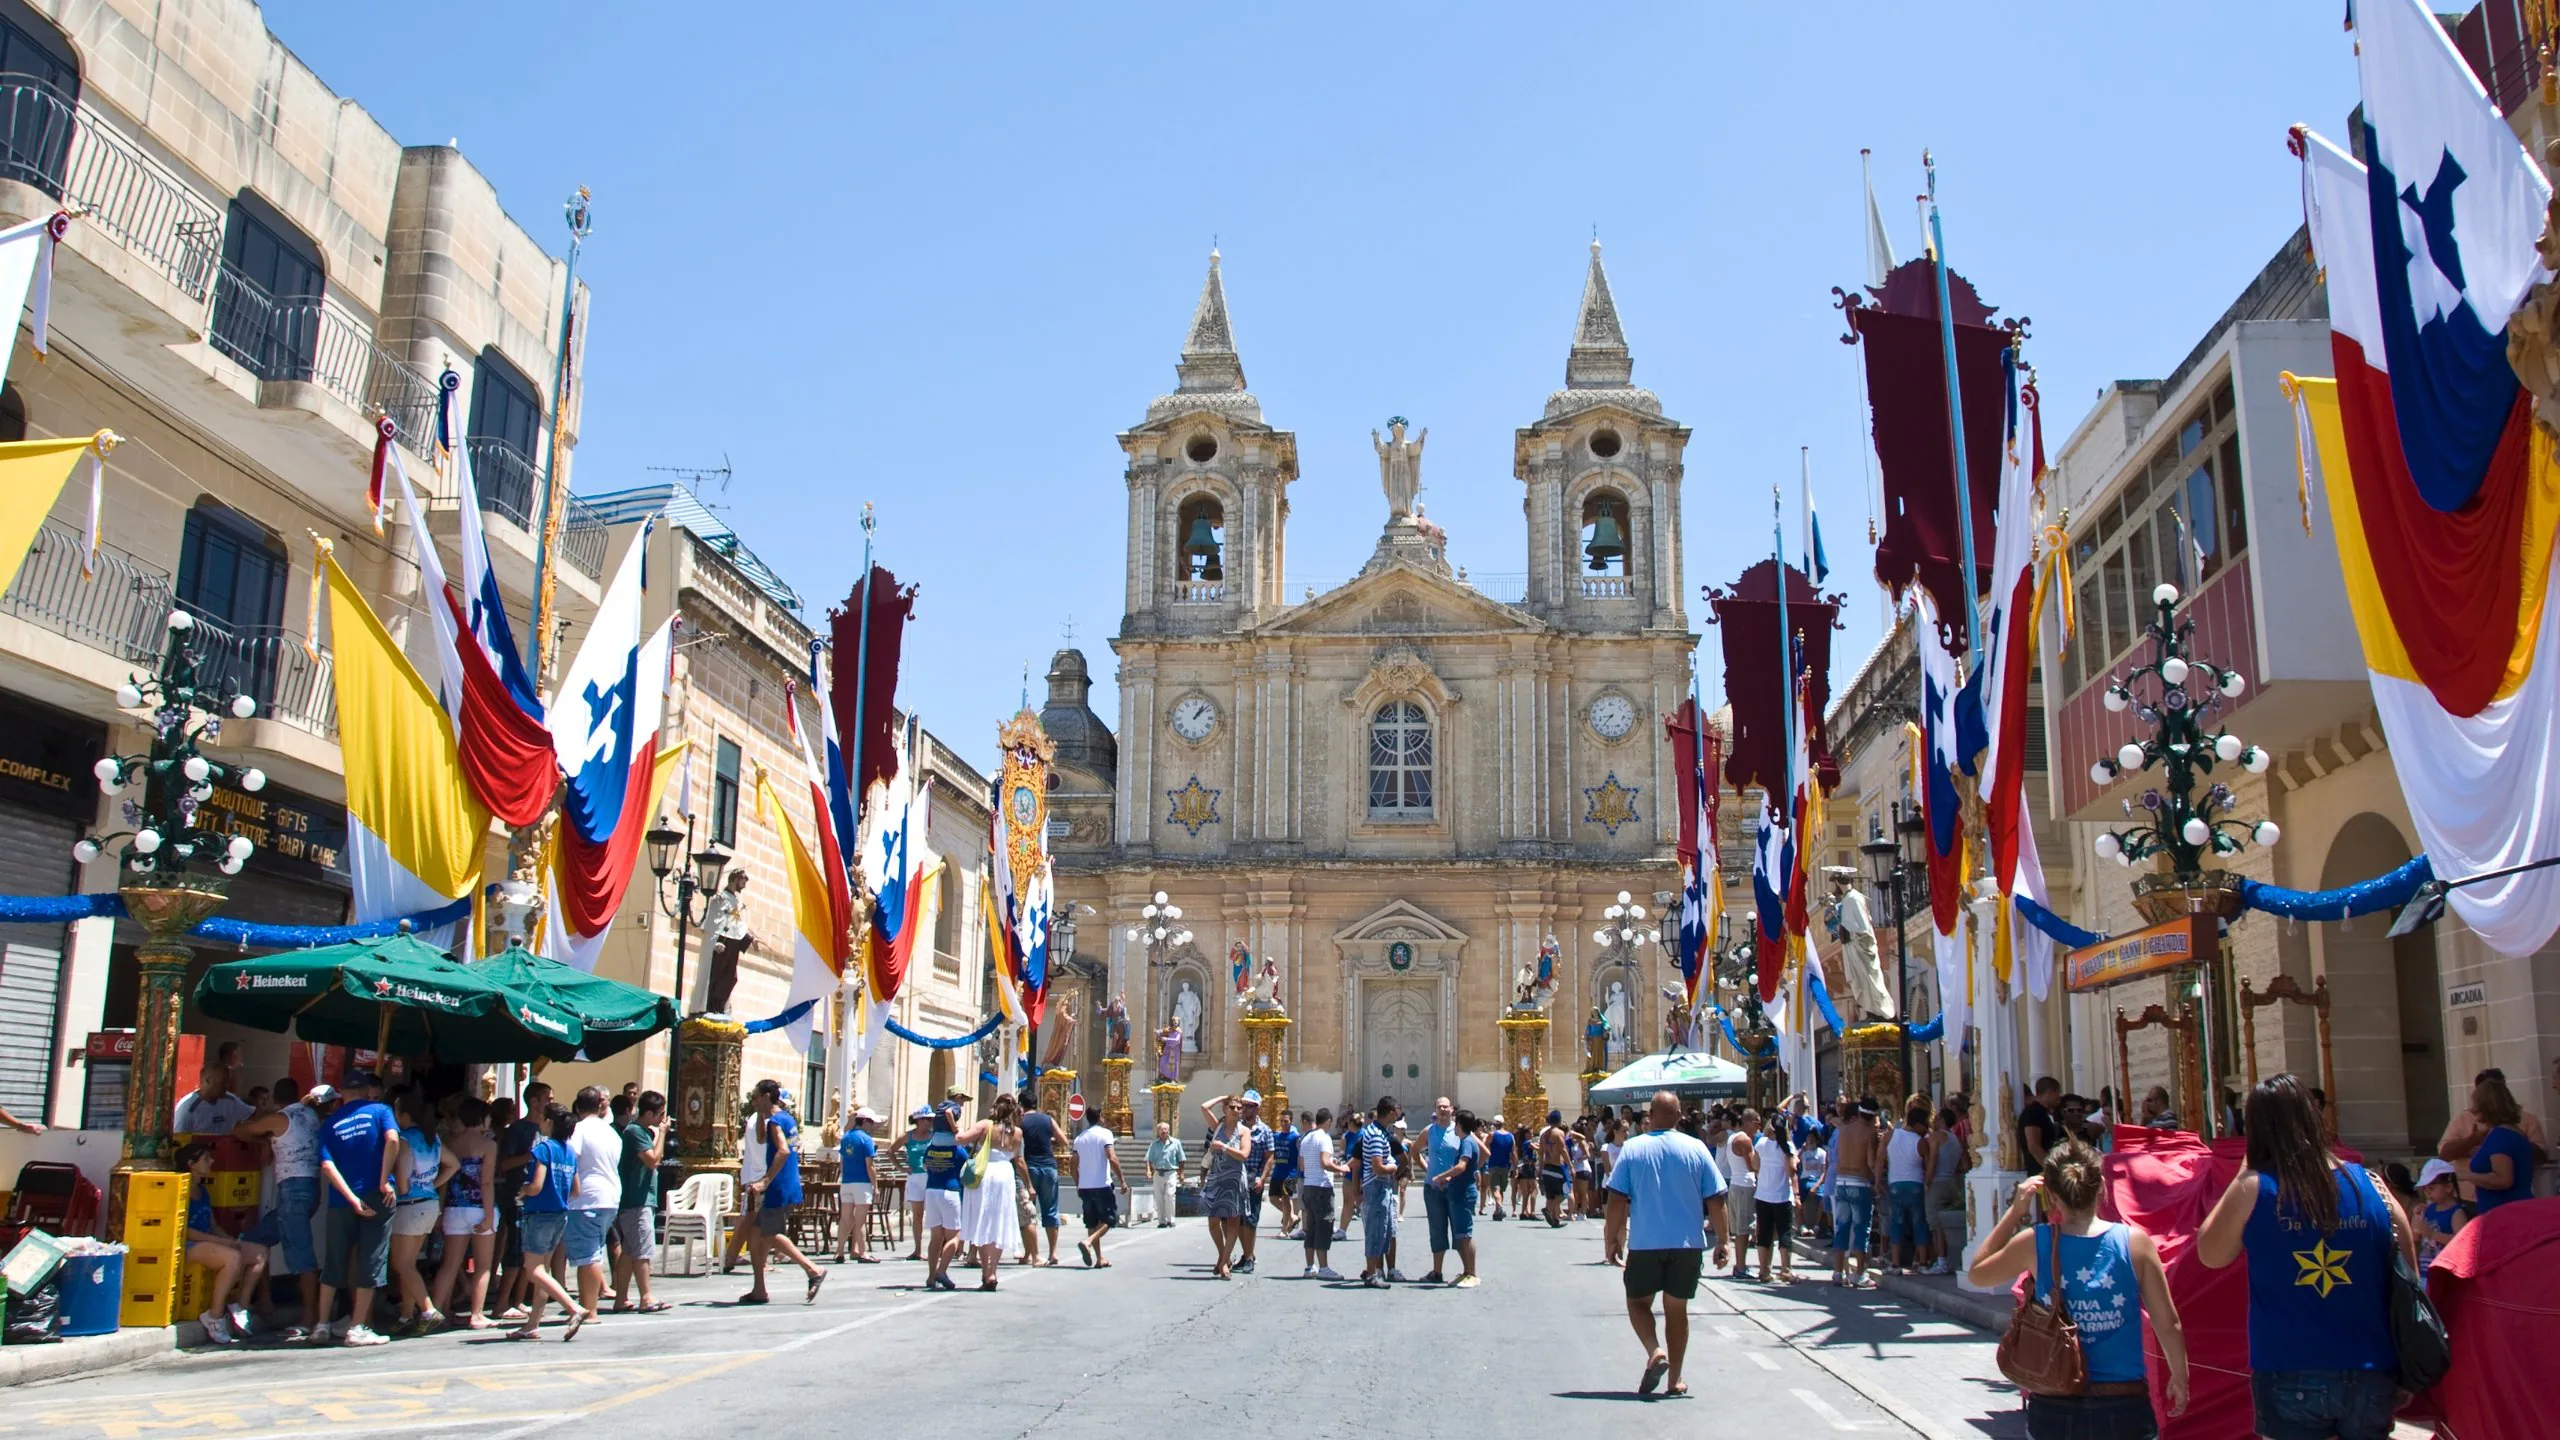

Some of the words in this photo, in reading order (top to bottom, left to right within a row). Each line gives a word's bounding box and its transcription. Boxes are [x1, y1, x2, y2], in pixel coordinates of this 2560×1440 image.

[0, 758, 71, 792] COMPLEX
[211, 785, 268, 821] BOUTIQUE
[277, 807, 308, 833] GIFTS
[278, 833, 306, 859] BABY
[310, 844, 337, 868] CARE
[252, 974, 307, 987] Heineken
[396, 984, 462, 1007] Heineken
[2450, 988, 2484, 1006] ARCADIA
[590, 1017, 633, 1028] Heineken
[1633, 1088, 1677, 1099] Heinn
[232, 1188, 251, 1197] CISK
[183, 1274, 193, 1305] CISK
[2068, 1300, 2100, 1310] VIVA
[2073, 1310, 2121, 1321] DONNA
